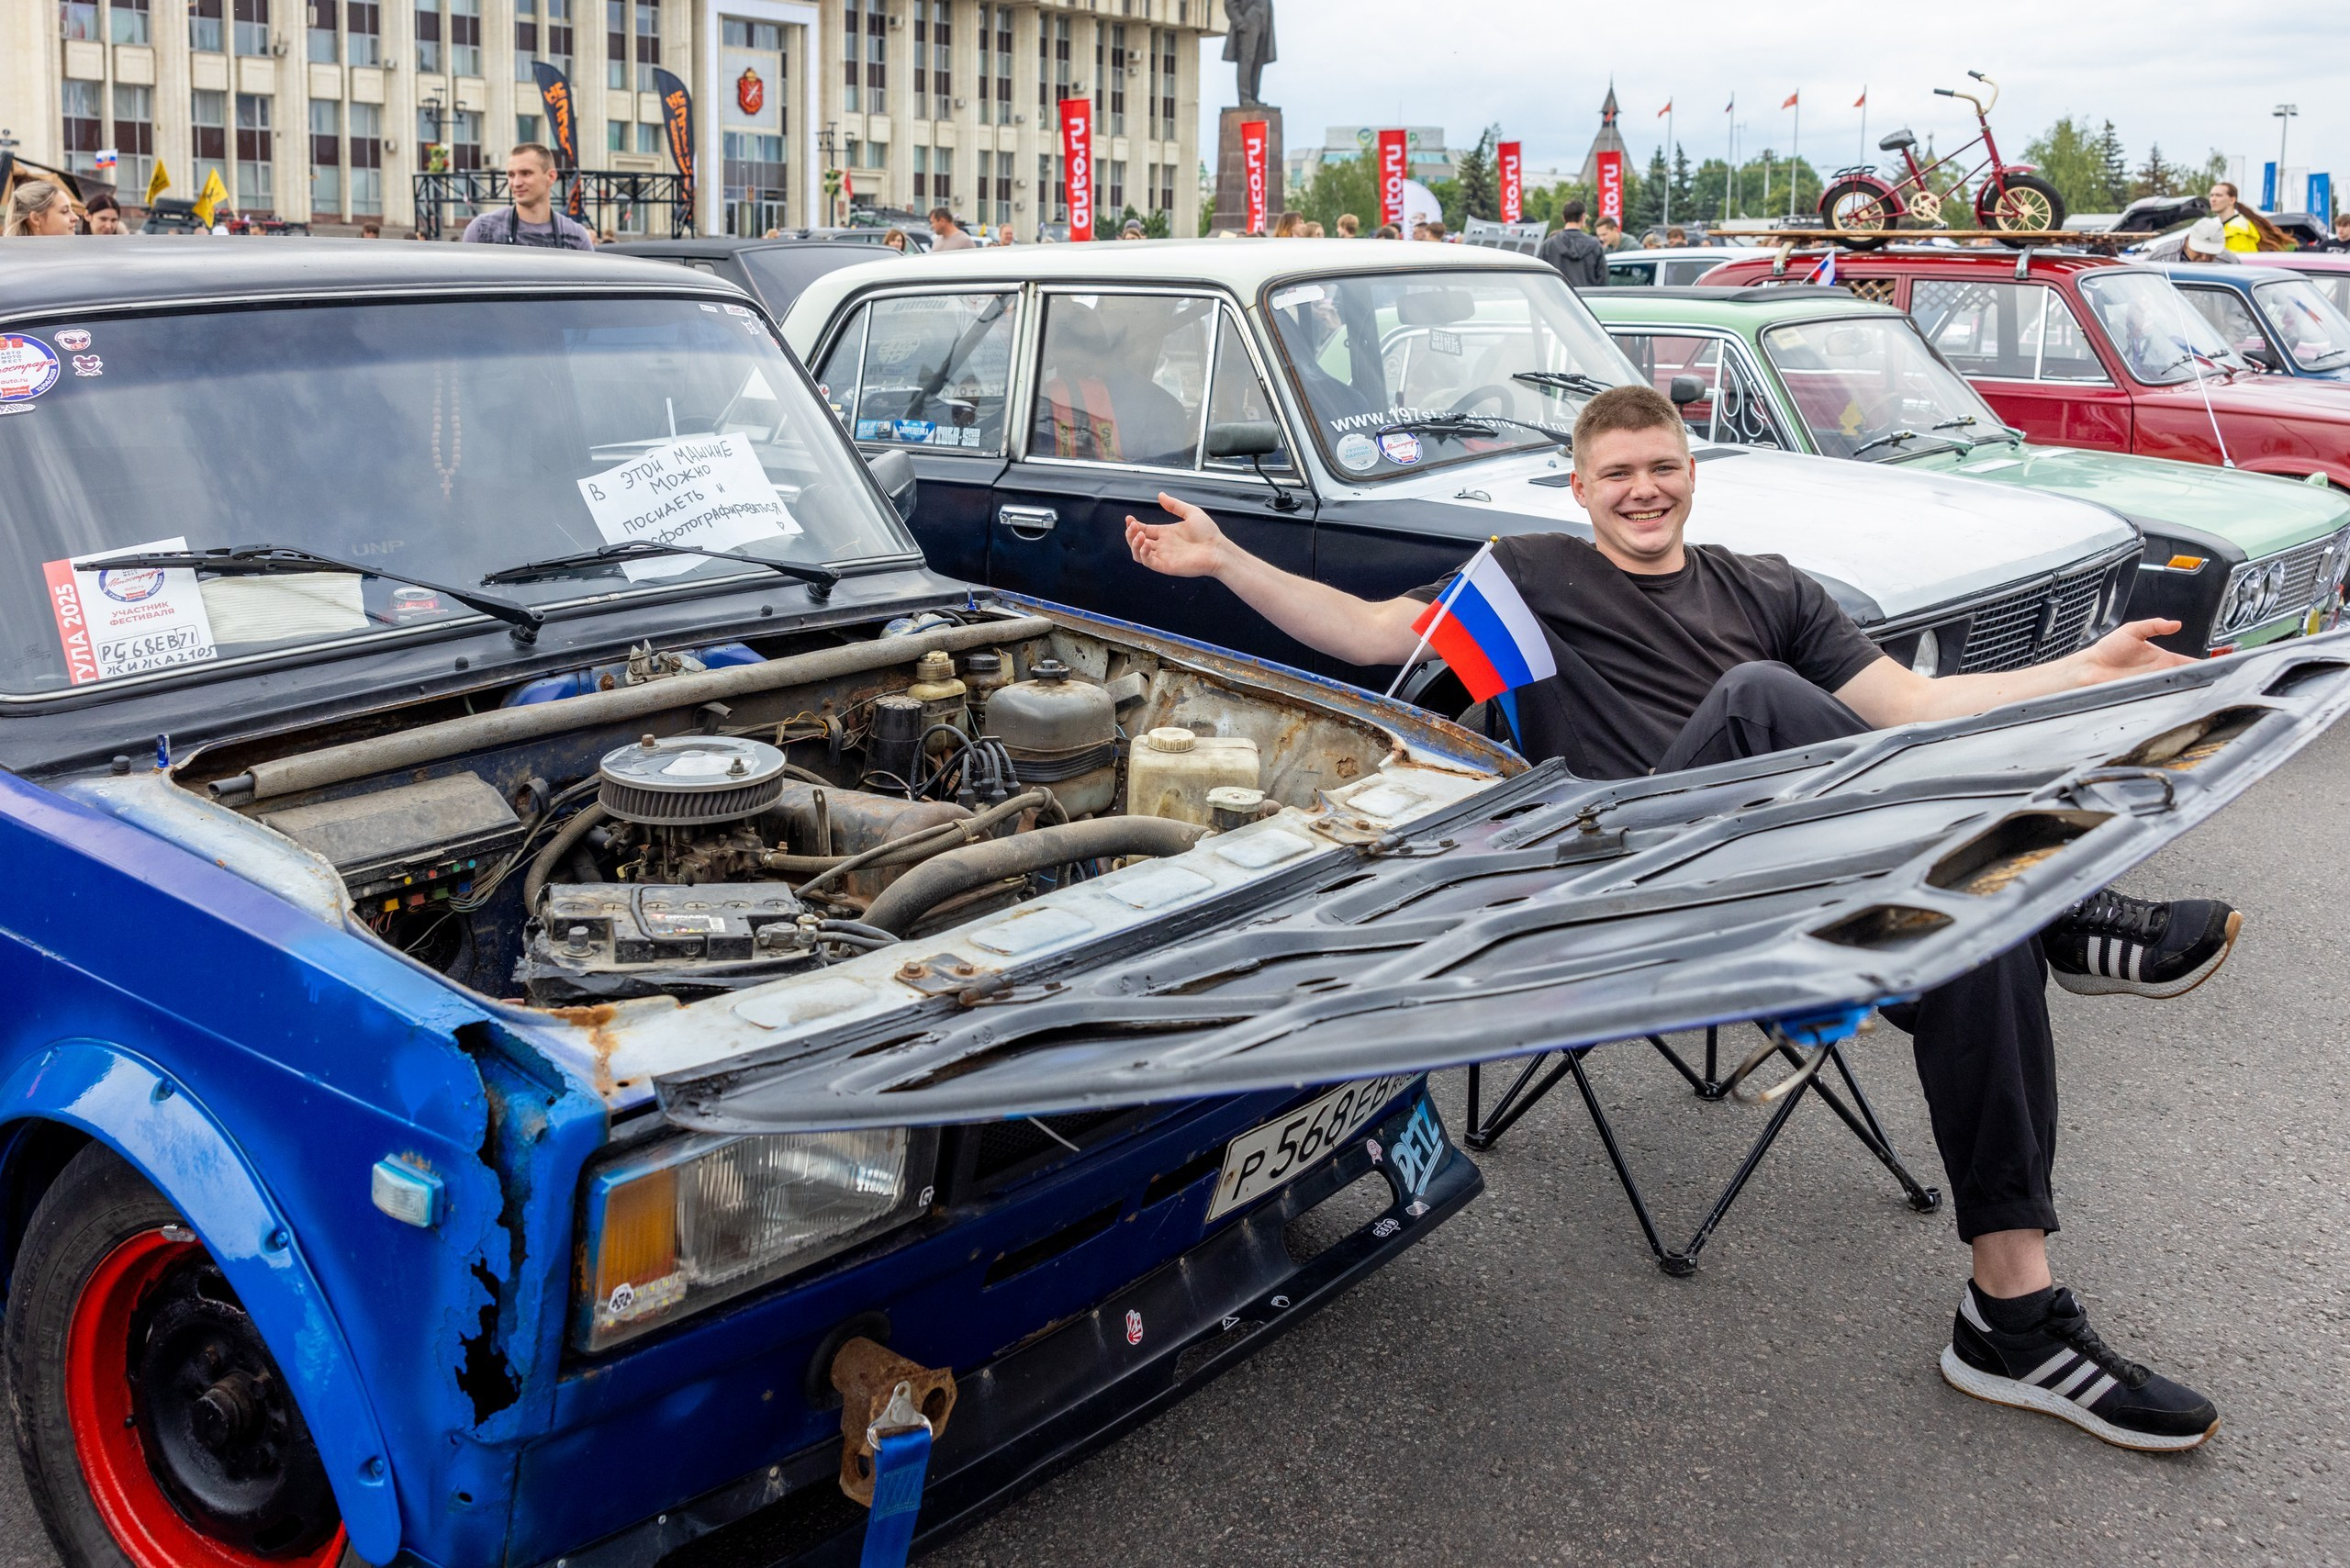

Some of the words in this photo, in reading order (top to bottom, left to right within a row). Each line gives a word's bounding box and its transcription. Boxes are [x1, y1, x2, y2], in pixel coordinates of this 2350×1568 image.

[1069, 118, 1090, 229] auto.ru
[1385, 144, 1403, 223] uto.ru
[1505, 155, 1522, 224] uto.ru
[588, 483, 606, 501] В
[621, 454, 664, 489] ЭТОЙ
[673, 440, 733, 465] МАШИНЕ
[1345, 445, 1370, 454] ГРУППА
[1345, 450, 1373, 459] ПАРОВОЗ
[649, 464, 711, 495] МОЖНО
[622, 489, 704, 534] ПОСИДЕТЬ
[55, 583, 83, 629] 2025
[109, 608, 175, 626] ФЕСТИВАЛЯ
[111, 601, 169, 618] УЧАСТНИК
[68, 630, 96, 684] ТУЛА
